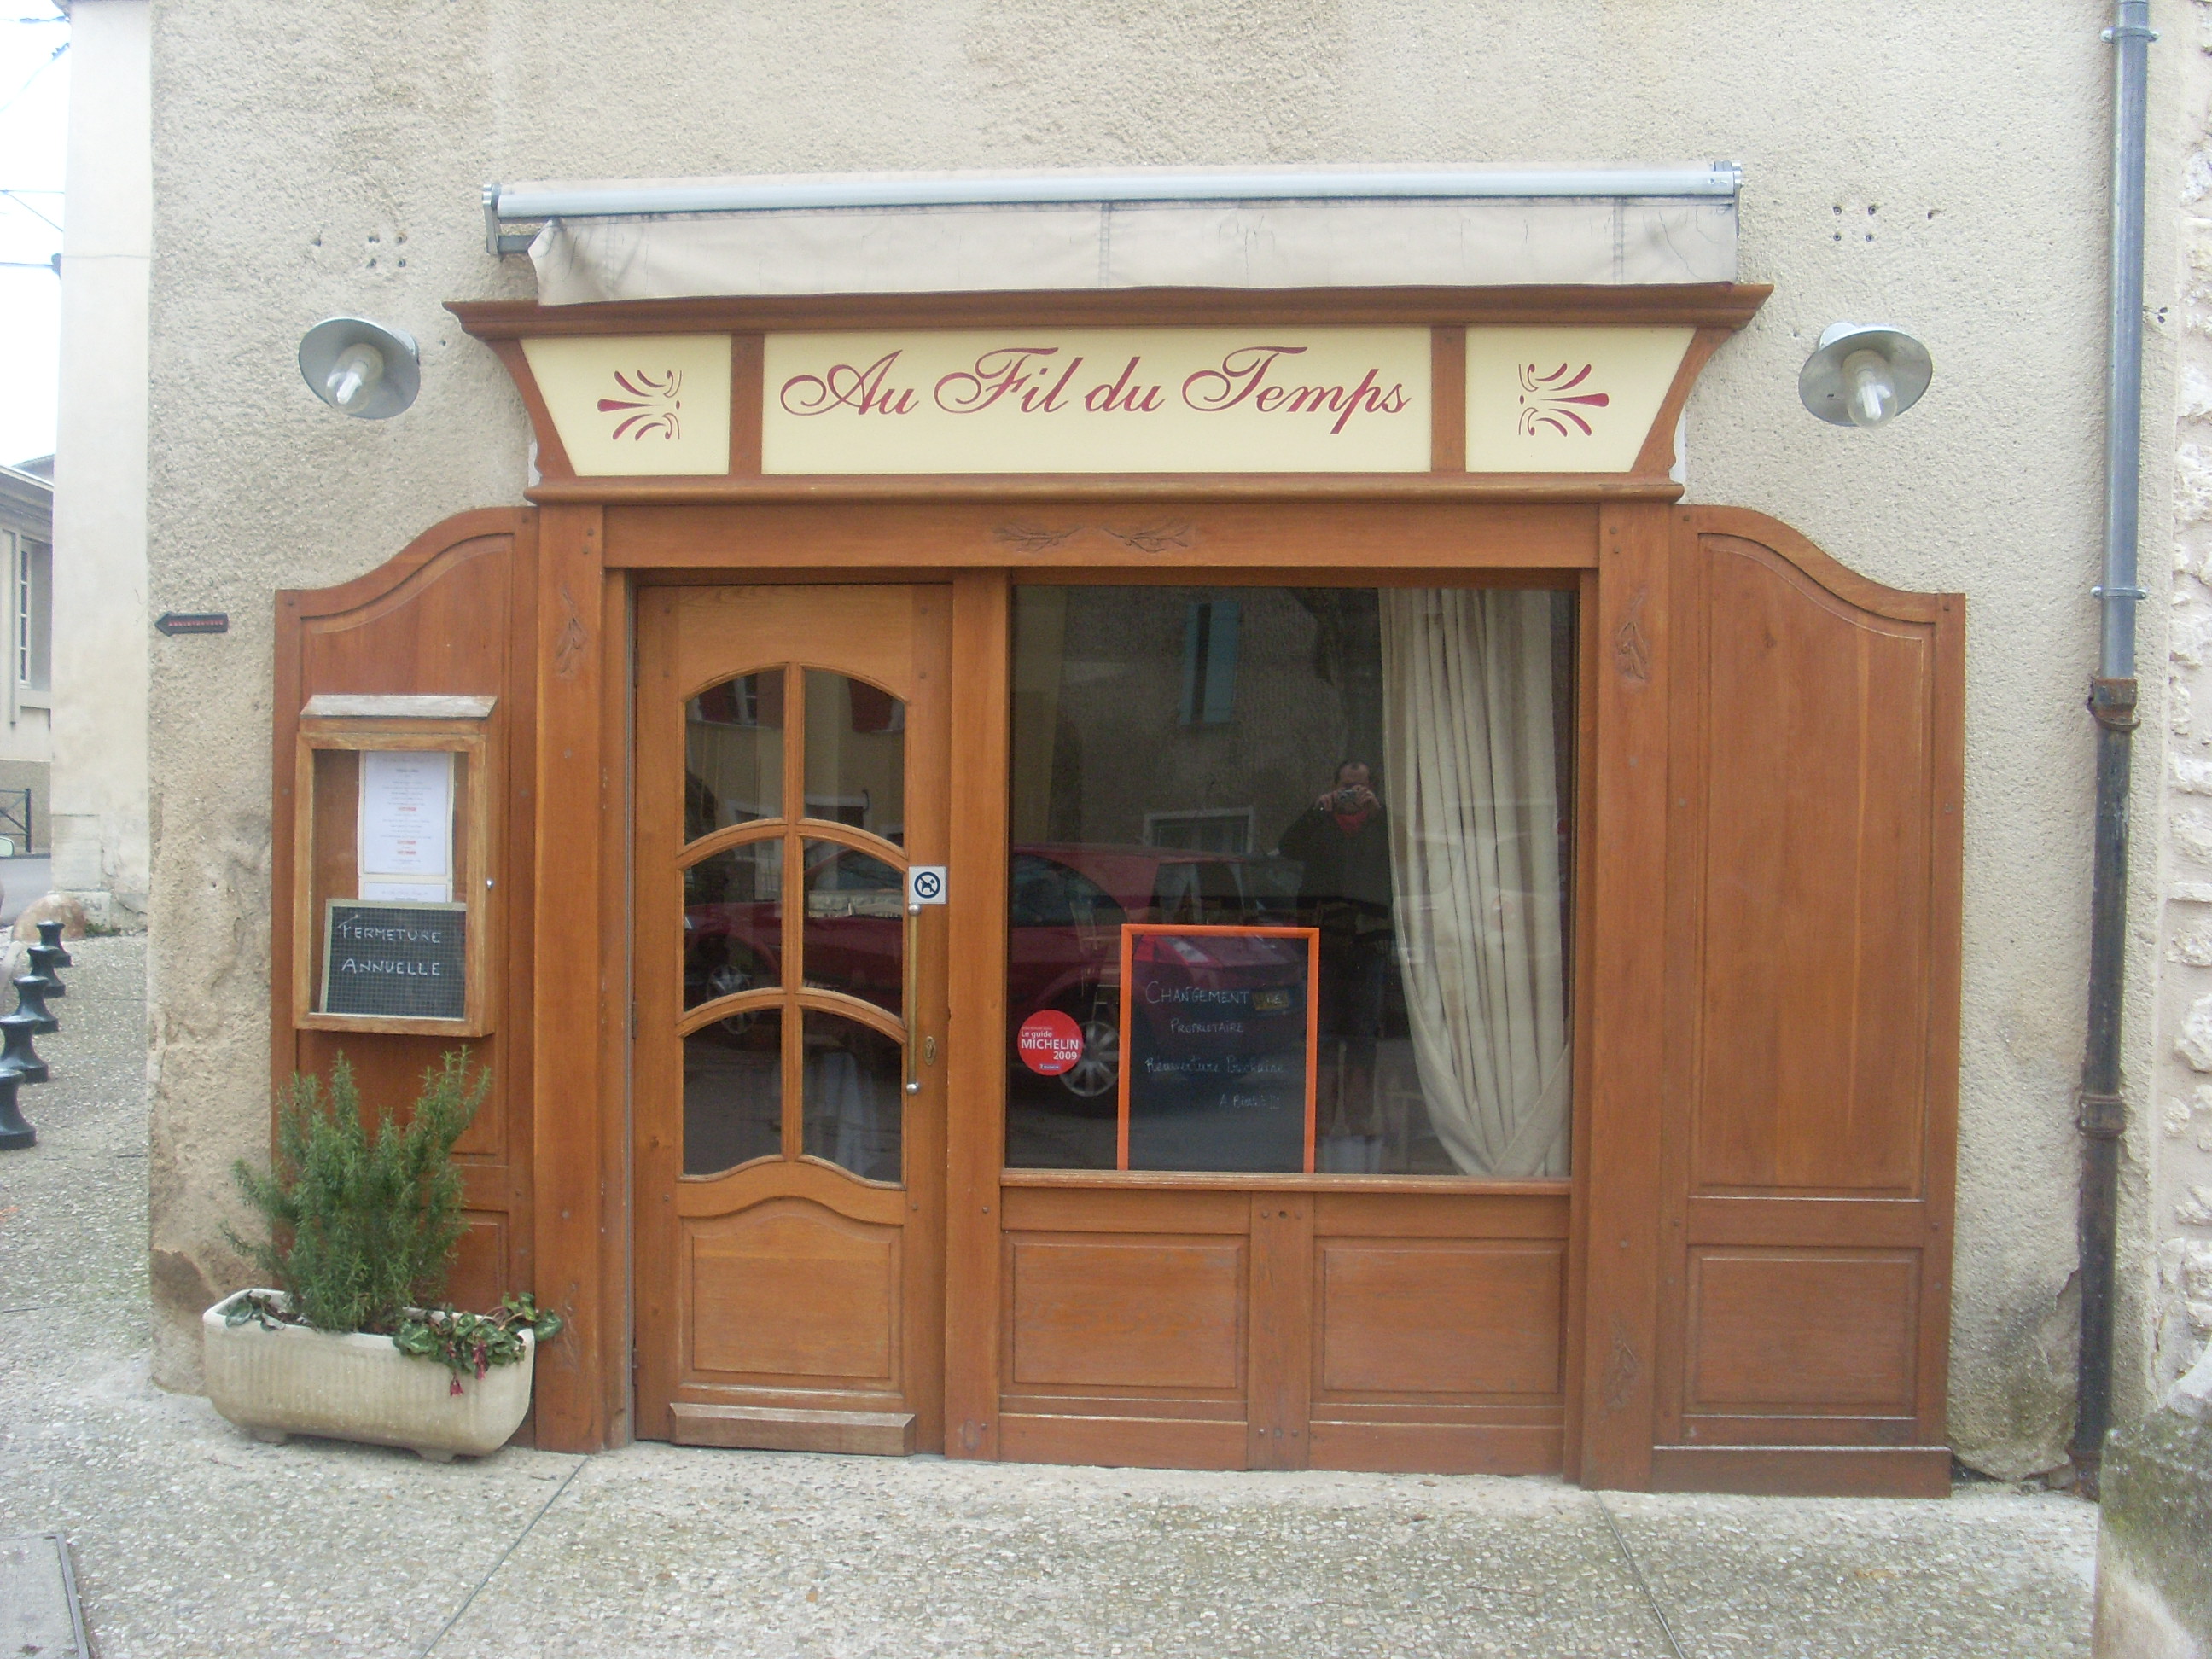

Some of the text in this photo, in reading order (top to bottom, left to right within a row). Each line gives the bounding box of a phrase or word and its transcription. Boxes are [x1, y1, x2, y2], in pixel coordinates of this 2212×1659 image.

[780, 346, 1412, 434] Au Fil du Temps
[338, 916, 442, 944] FERMETURE
[341, 958, 441, 976] ANNUELLE
[1145, 981, 1249, 1004] CHANGEMENT
[1031, 1030, 1052, 1039] guide
[1021, 1039, 1079, 1050] MICHELIN
[1053, 1051, 1078, 1060] 2009
